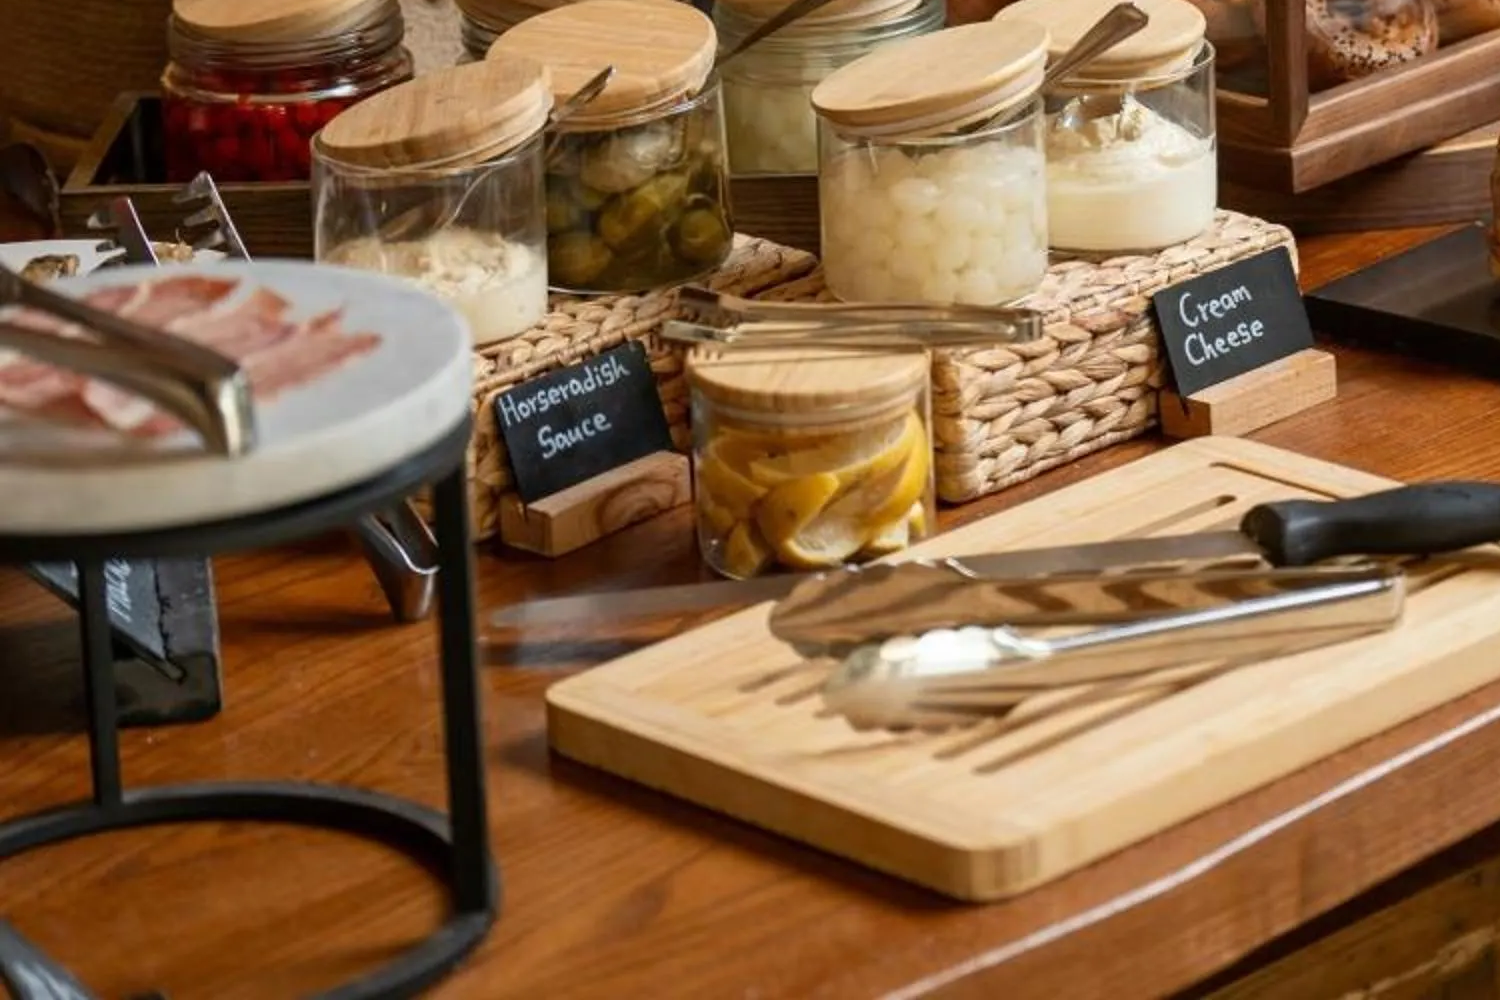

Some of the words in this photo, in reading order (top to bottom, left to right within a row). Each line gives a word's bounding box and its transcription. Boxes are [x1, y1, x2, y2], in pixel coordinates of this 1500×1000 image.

[1179, 284, 1253, 328] Cream
[1184, 318, 1264, 366] Cheese
[499, 355, 631, 429] Horseradish
[537, 411, 612, 460] Sauce
